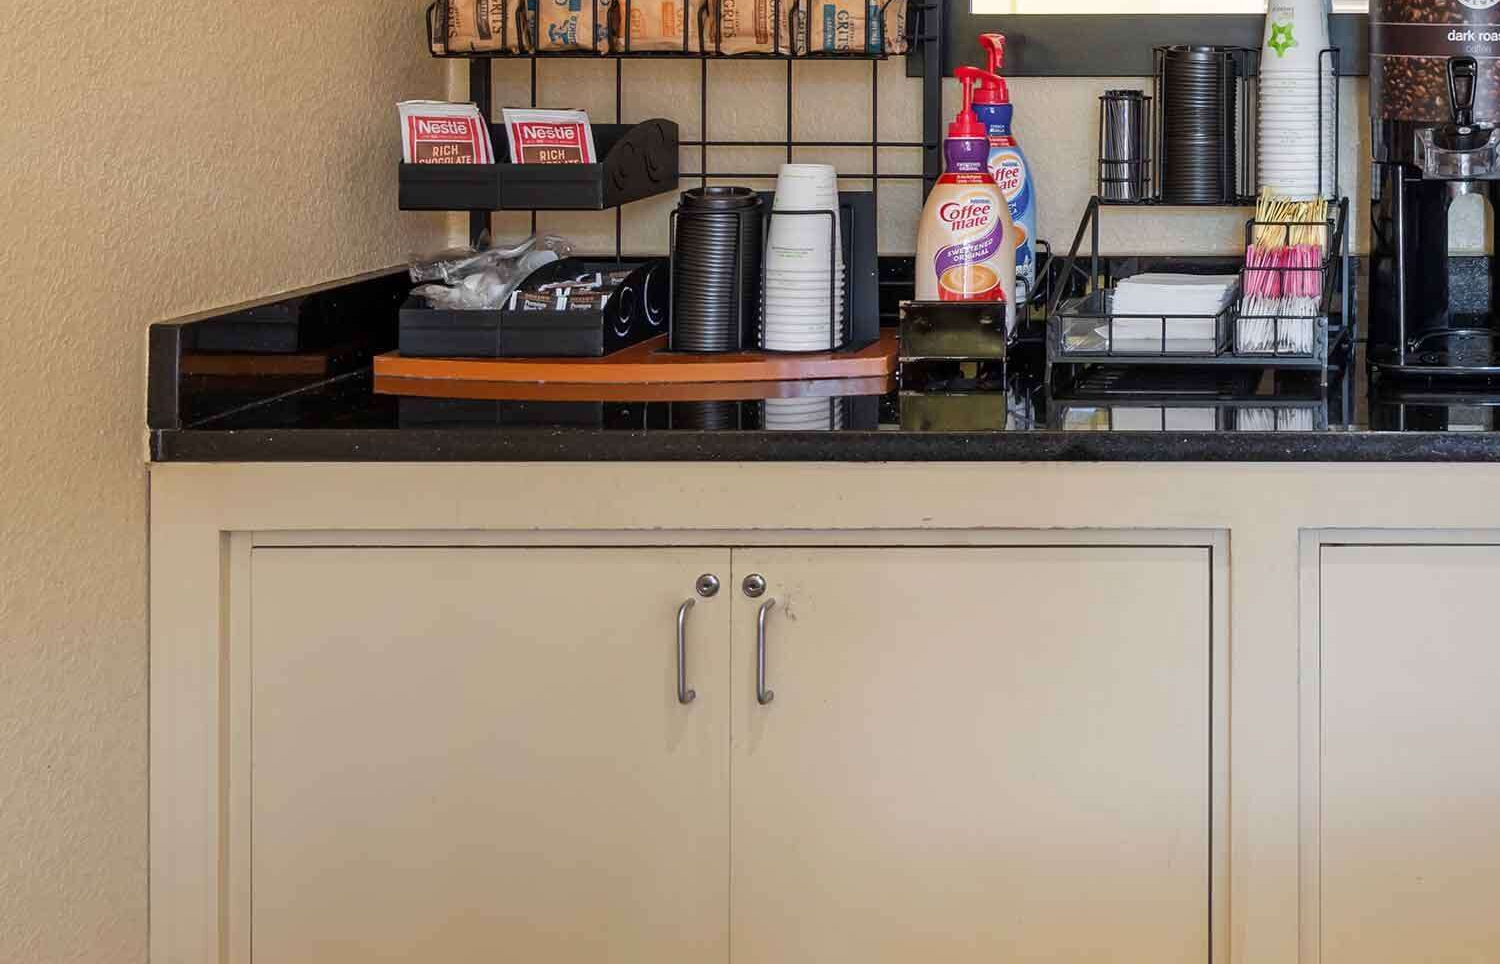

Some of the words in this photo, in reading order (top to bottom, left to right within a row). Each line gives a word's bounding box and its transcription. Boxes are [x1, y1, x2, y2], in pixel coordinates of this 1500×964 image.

[1448, 29, 1475, 41] dark
[433, 145, 459, 157] RICH
[540, 149, 565, 161] RICH
[940, 202, 991, 223] Coffee
[952, 216, 988, 231] mate
